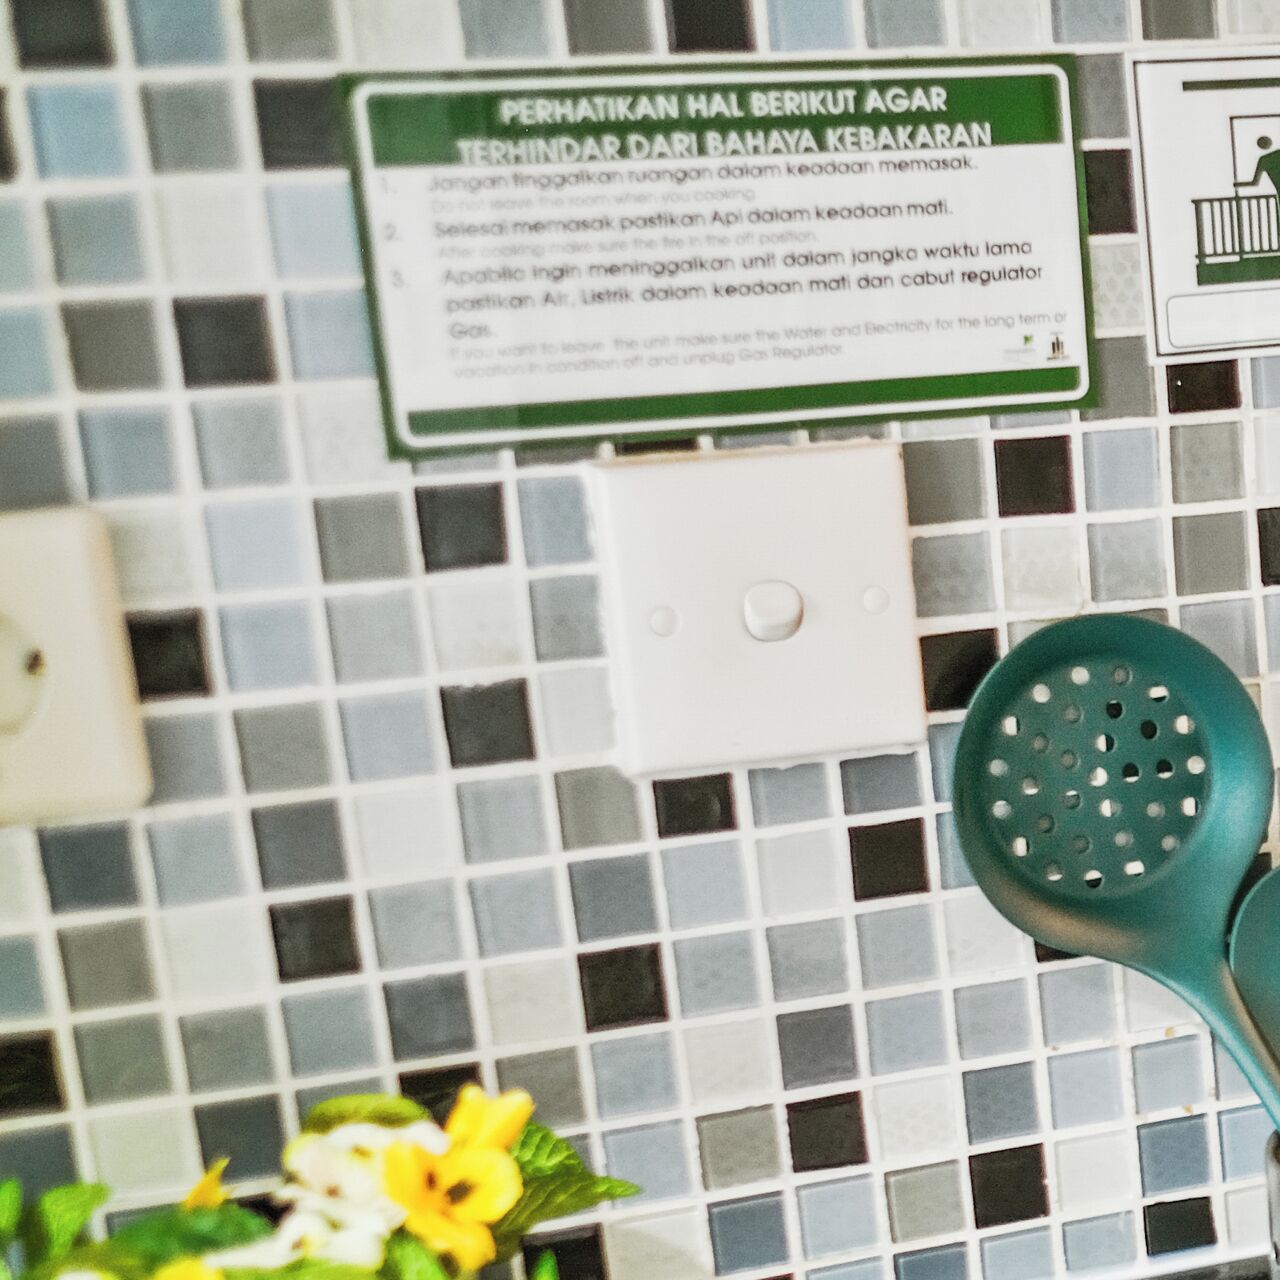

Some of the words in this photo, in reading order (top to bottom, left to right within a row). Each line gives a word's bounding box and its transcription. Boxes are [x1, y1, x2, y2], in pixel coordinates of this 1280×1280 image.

[500, 94, 680, 125] PERHATIKAN
[686, 91, 745, 118] HAL
[750, 88, 857, 117] BERIKUT
[863, 85, 948, 113] AGAR
[457, 135, 622, 166] TERHINDAR
[626, 132, 699, 160] DARI
[705, 127, 819, 156] BAHAYA
[825, 121, 993, 151] KEBAKARAN
[430, 174, 508, 195] Jangan
[512, 169, 624, 192] tinggalkan
[628, 166, 714, 186] ruangan
[718, 162, 782, 180] dalam
[786, 159, 875, 178] keadaan
[878, 154, 979, 175] memasak.
[434, 220, 505, 238] Selesai
[513, 215, 614, 233] memasak
[620, 212, 706, 232] pastikan
[711, 209, 743, 228] Api
[747, 207, 811, 224] dalam
[815, 202, 903, 221] keadaan
[907, 198, 954, 217] mati.
[444, 267, 526, 286] Apabila
[532, 264, 582, 284] ingin
[589, 255, 735, 277] meninggalkan
[741, 252, 776, 270] unit
[783, 249, 845, 268] dalam
[851, 246, 918, 267] jangka
[923, 243, 980, 260] waktu
[985, 240, 1033, 257] lama
[445, 293, 536, 313] pastikan
[581, 286, 635, 306] Listrik
[641, 283, 708, 302] dalam
[713, 277, 804, 298] keadaan
[809, 274, 850, 293] mati
[857, 272, 894, 290] dan
[900, 268, 955, 288] cabut
[961, 265, 1044, 287] regulator
